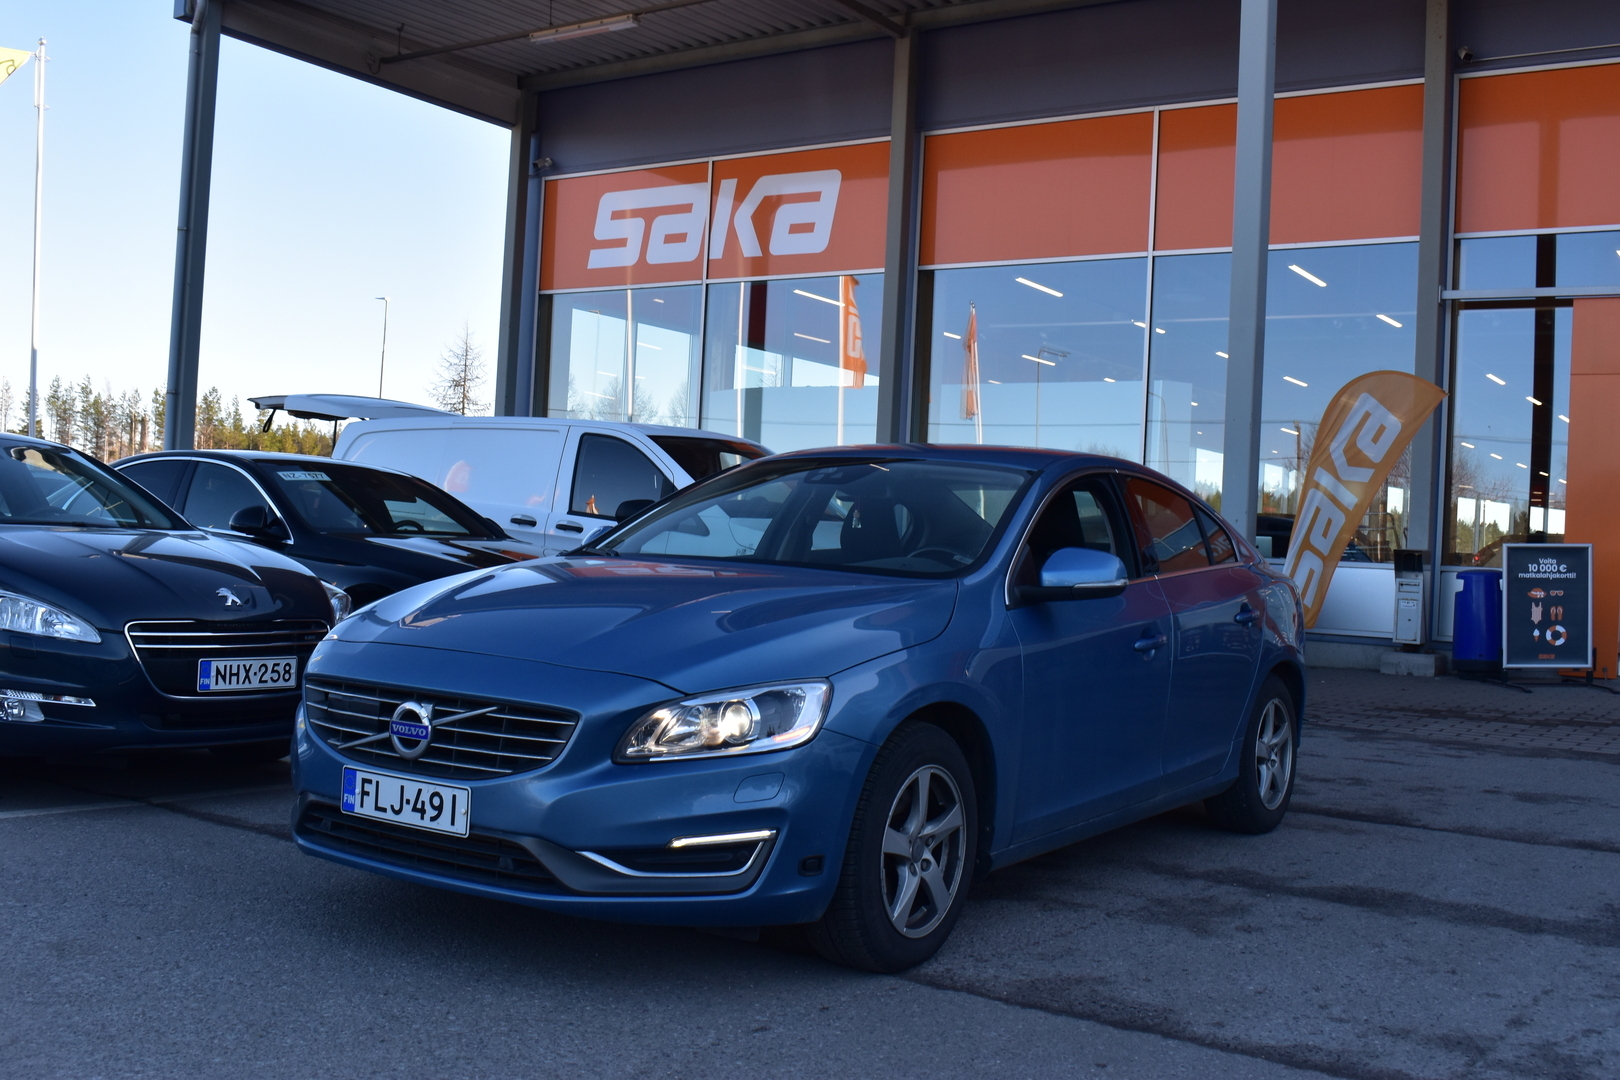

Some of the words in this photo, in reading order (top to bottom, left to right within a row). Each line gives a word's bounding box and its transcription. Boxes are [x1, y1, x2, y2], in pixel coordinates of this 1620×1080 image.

[1528, 564, 1538, 572] 10
[1539, 564, 1558, 572] 000
[1559, 564, 1567, 572] €
[1519, 572, 1576, 580] matkalahjakortti!
[215, 662, 292, 686] NHX-258
[392, 723, 427, 737] VOLVO
[343, 793, 355, 805] FIN
[359, 777, 457, 827] FLJ-491
